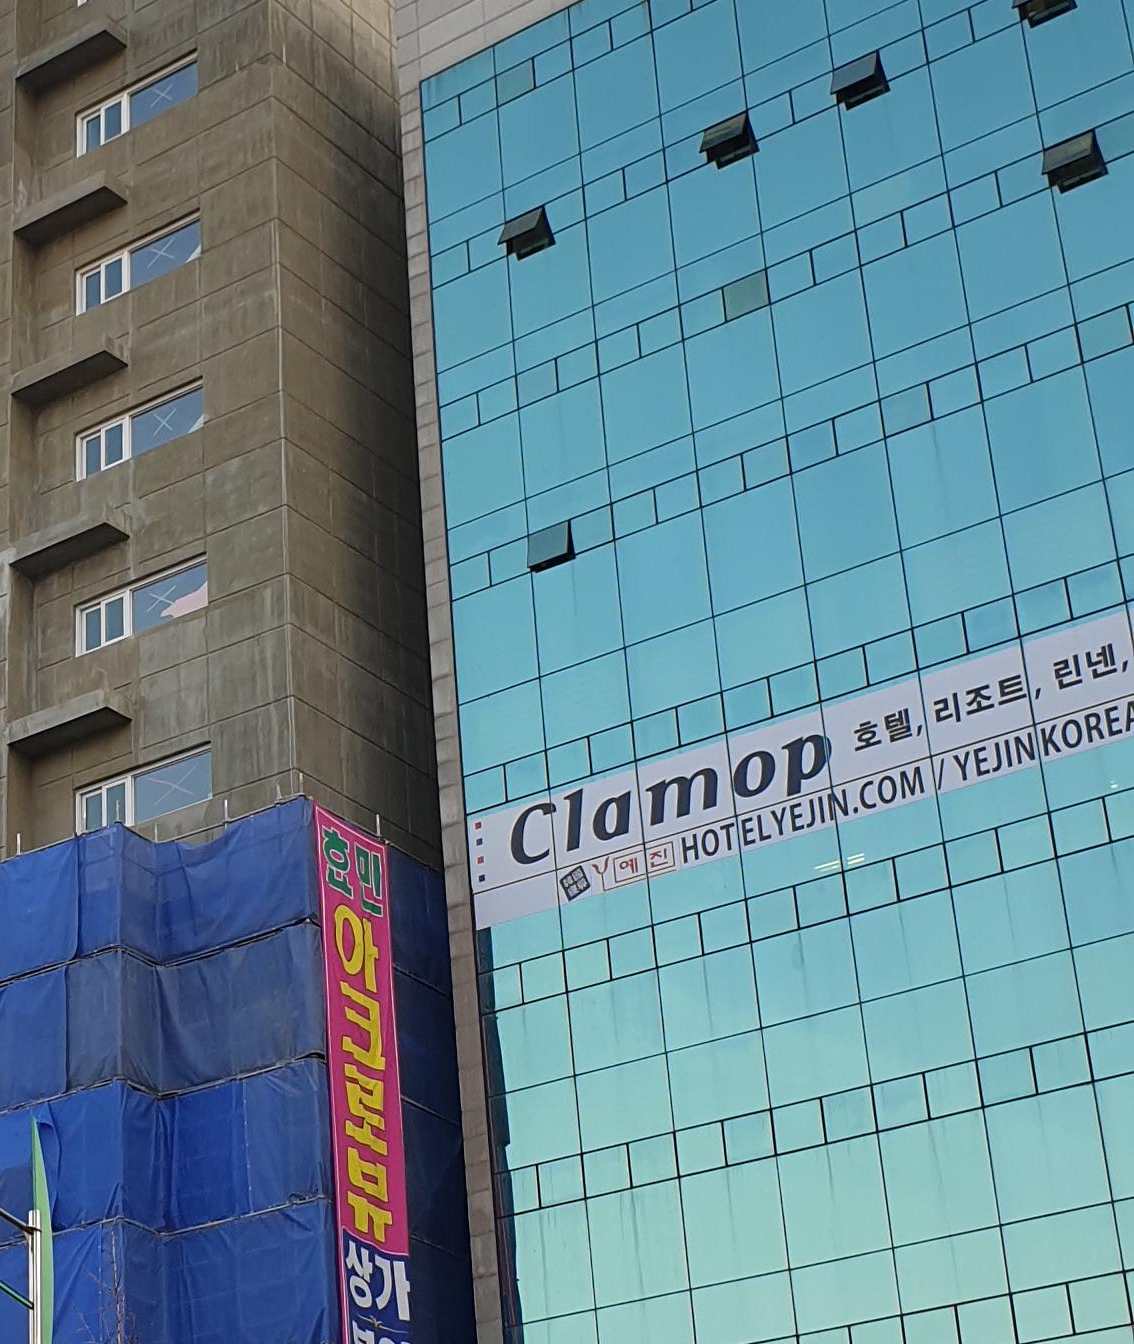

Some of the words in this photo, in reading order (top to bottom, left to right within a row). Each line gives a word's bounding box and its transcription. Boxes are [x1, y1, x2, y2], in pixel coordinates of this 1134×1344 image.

[854, 708, 922, 752] 호텔,
[933, 674, 1041, 723] 리조트,
[1053, 643, 1128, 690] 린넨,
[510, 734, 832, 864] Clamop
[681, 766, 925, 863] HOTELYEJIN.COM
[321, 825, 383, 917] 효민
[346, 1240, 411, 1321] 상가
